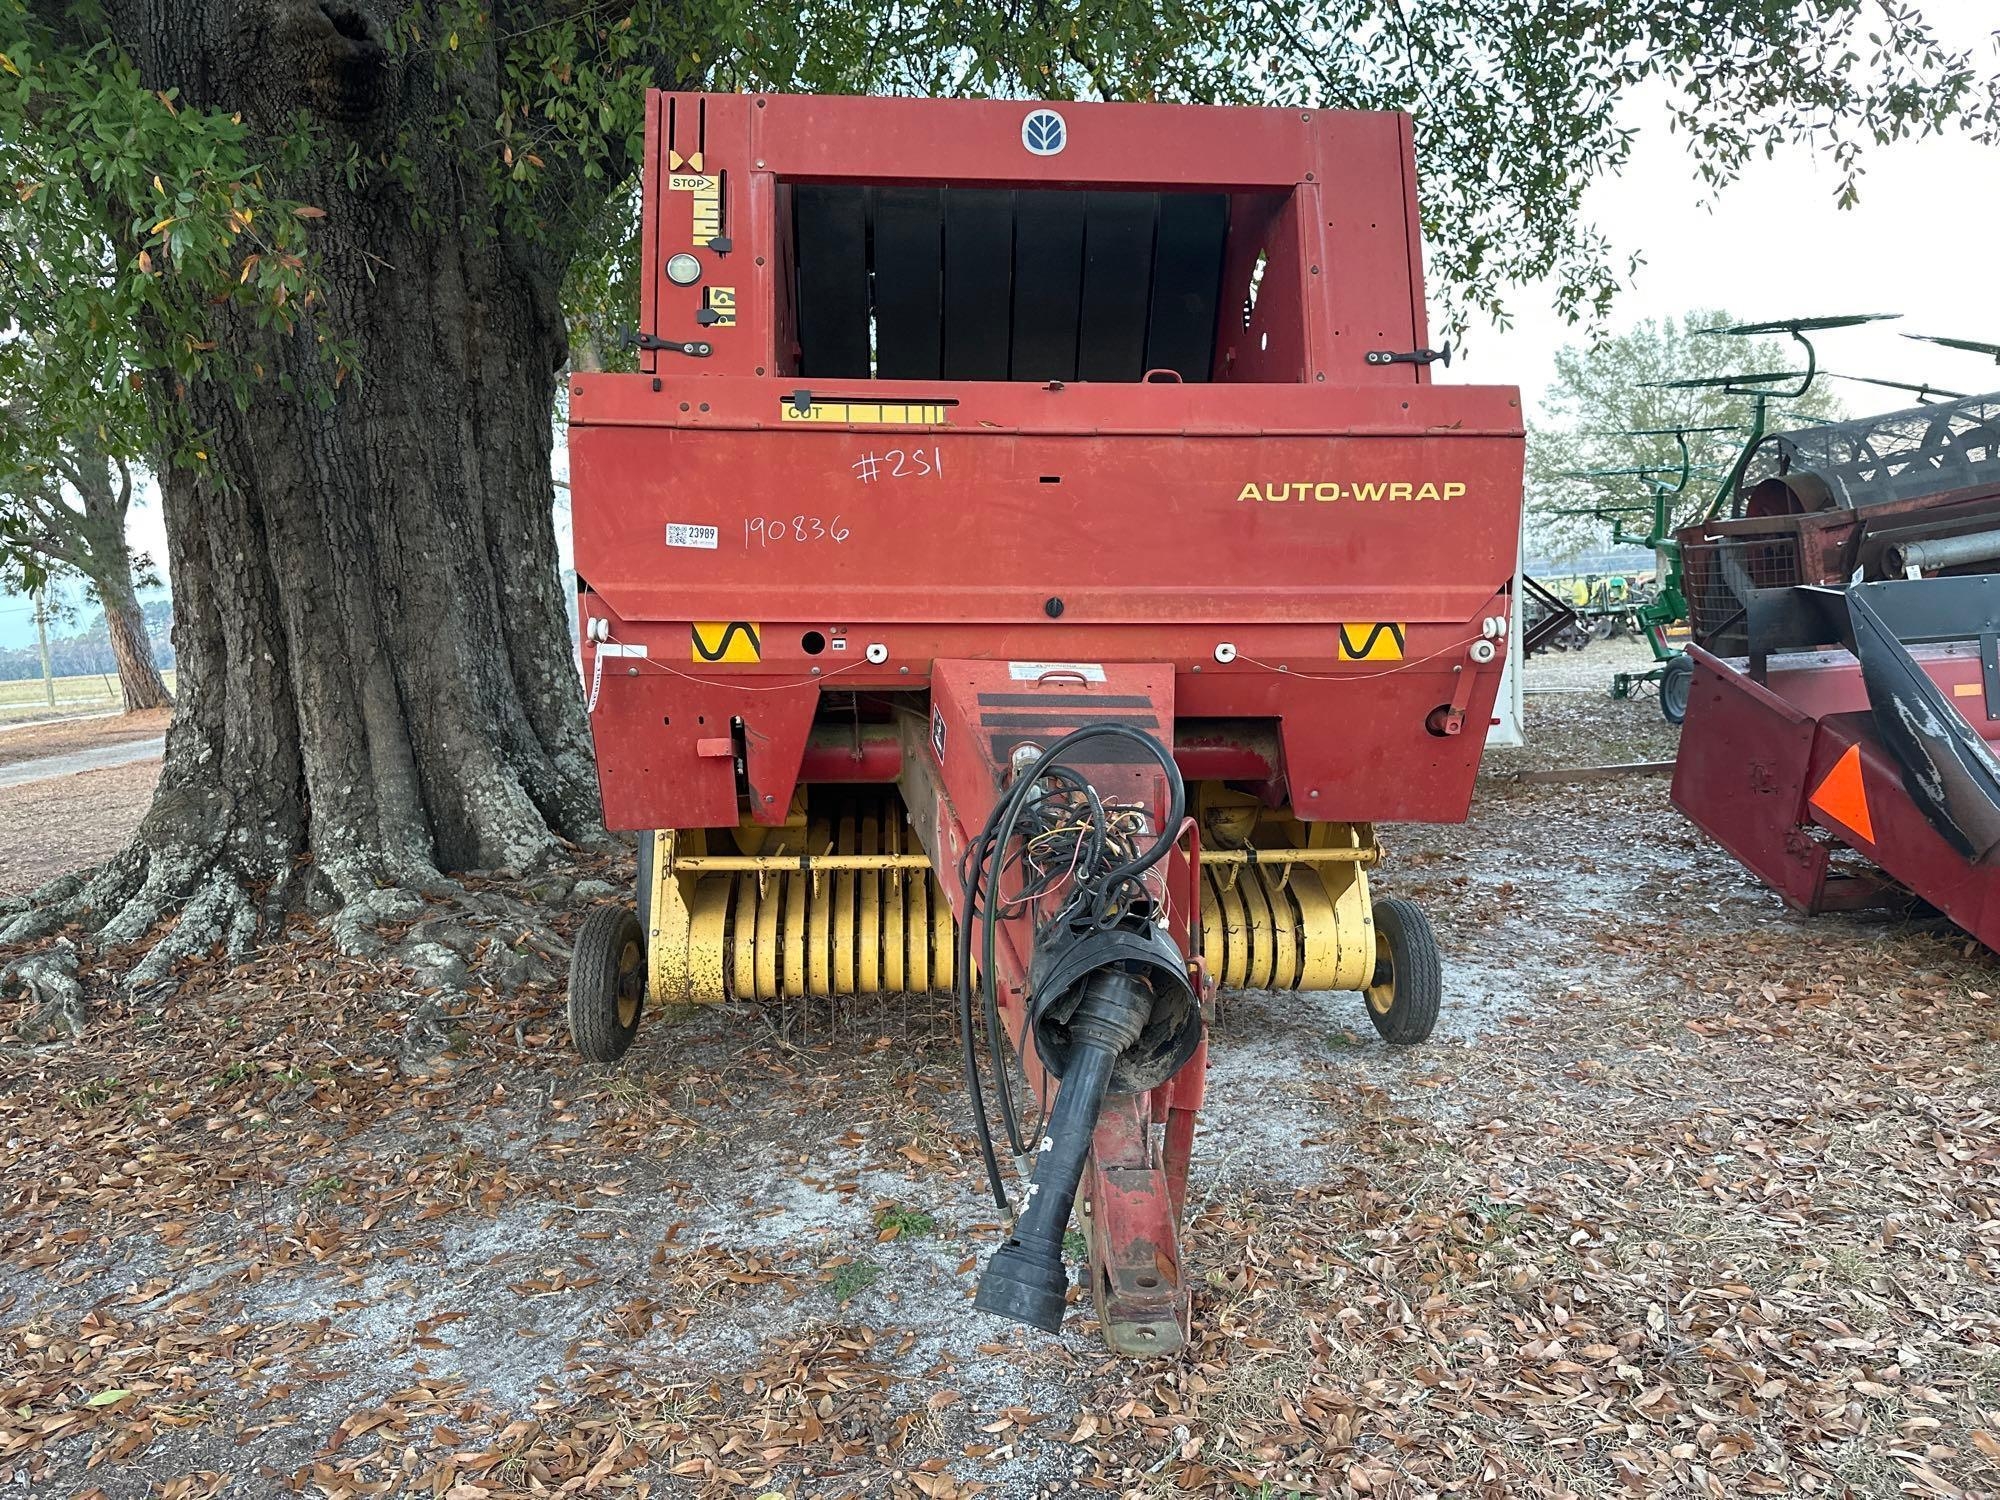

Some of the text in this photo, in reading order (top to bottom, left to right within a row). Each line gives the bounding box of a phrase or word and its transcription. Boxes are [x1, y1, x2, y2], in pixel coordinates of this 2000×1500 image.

[673, 178, 704, 188] STOP
[1237, 482, 1467, 502] AUTO-WRAP
[688, 526, 715, 540] 23989
[745, 514, 850, 550] 190836
